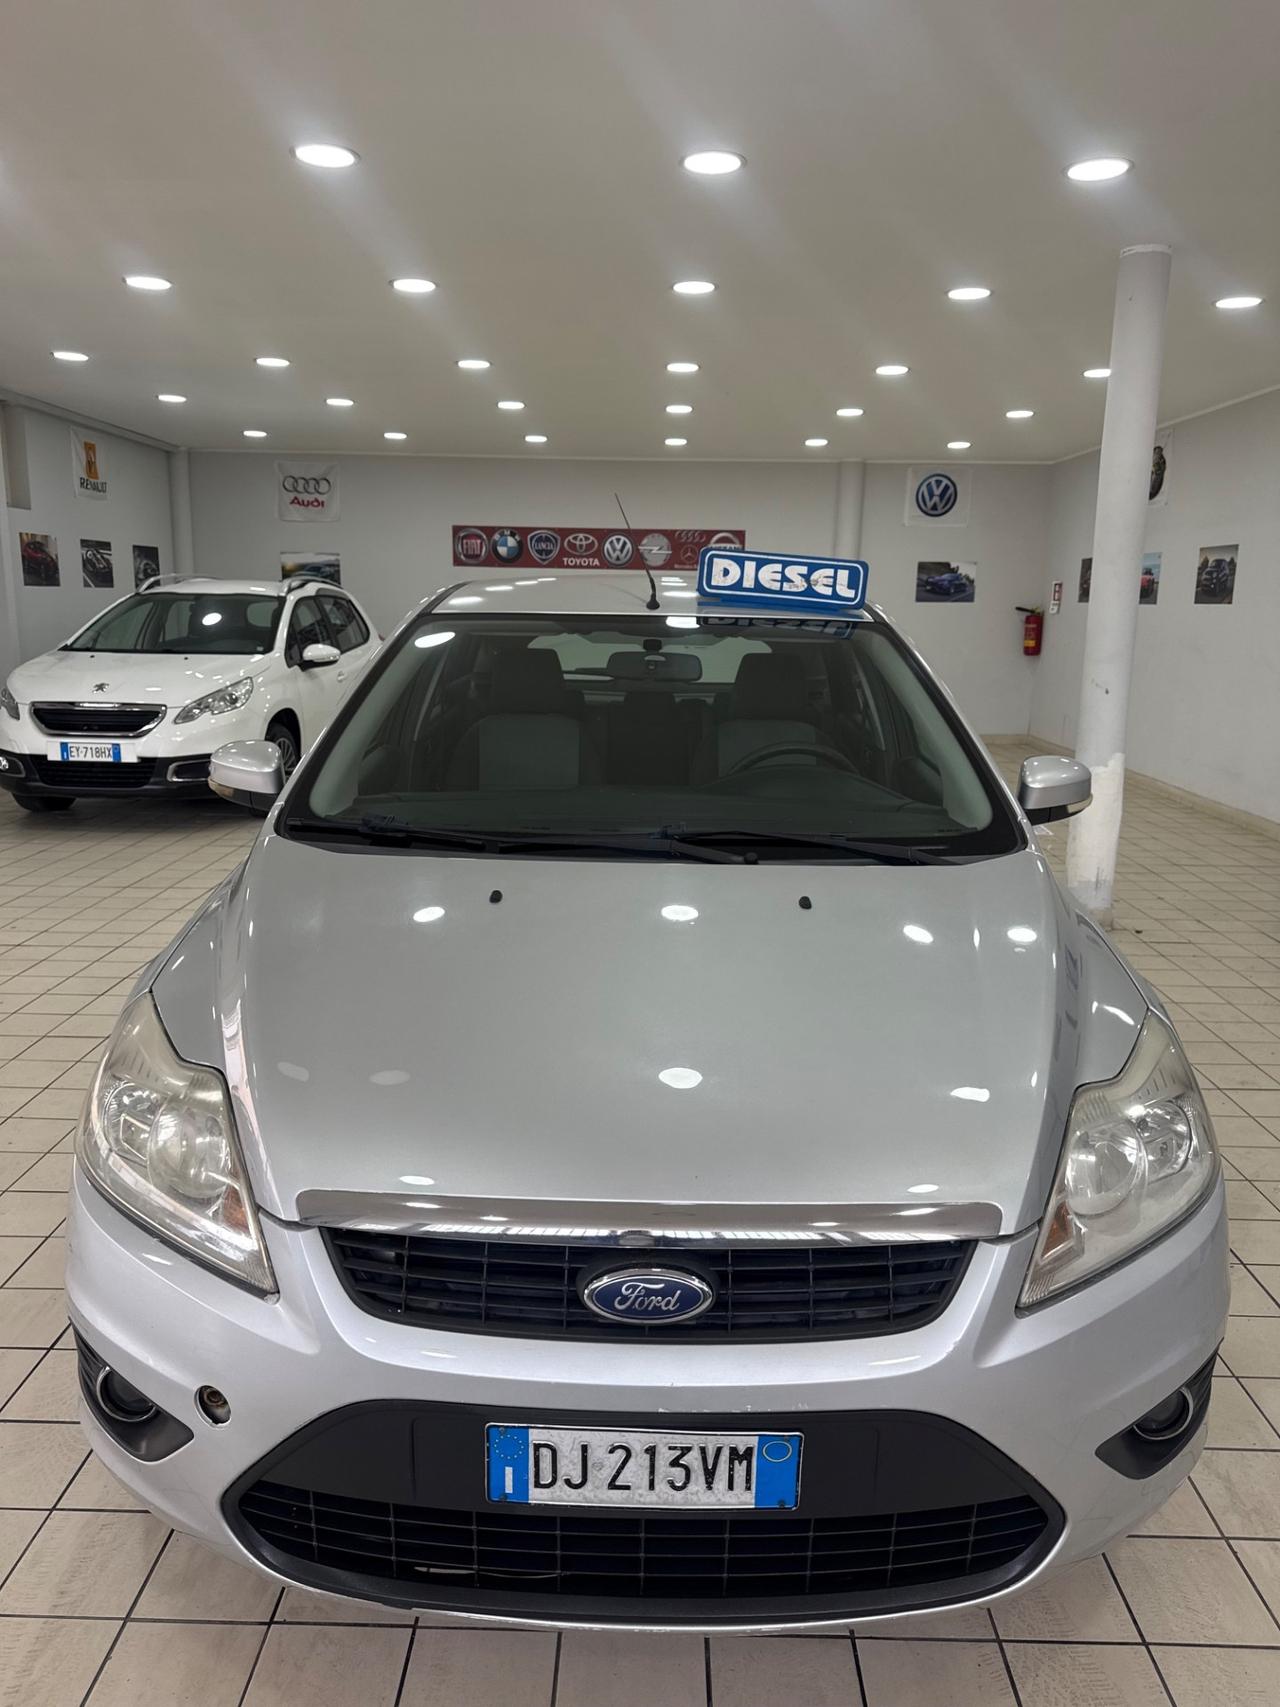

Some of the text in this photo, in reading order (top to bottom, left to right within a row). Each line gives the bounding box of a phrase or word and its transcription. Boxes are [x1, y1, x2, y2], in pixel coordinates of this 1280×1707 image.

[463, 539, 481, 554] FIAT
[562, 557, 600, 566] TOYOTA
[711, 558, 856, 599] DIESEL
[614, 1281, 681, 1311] Ford
